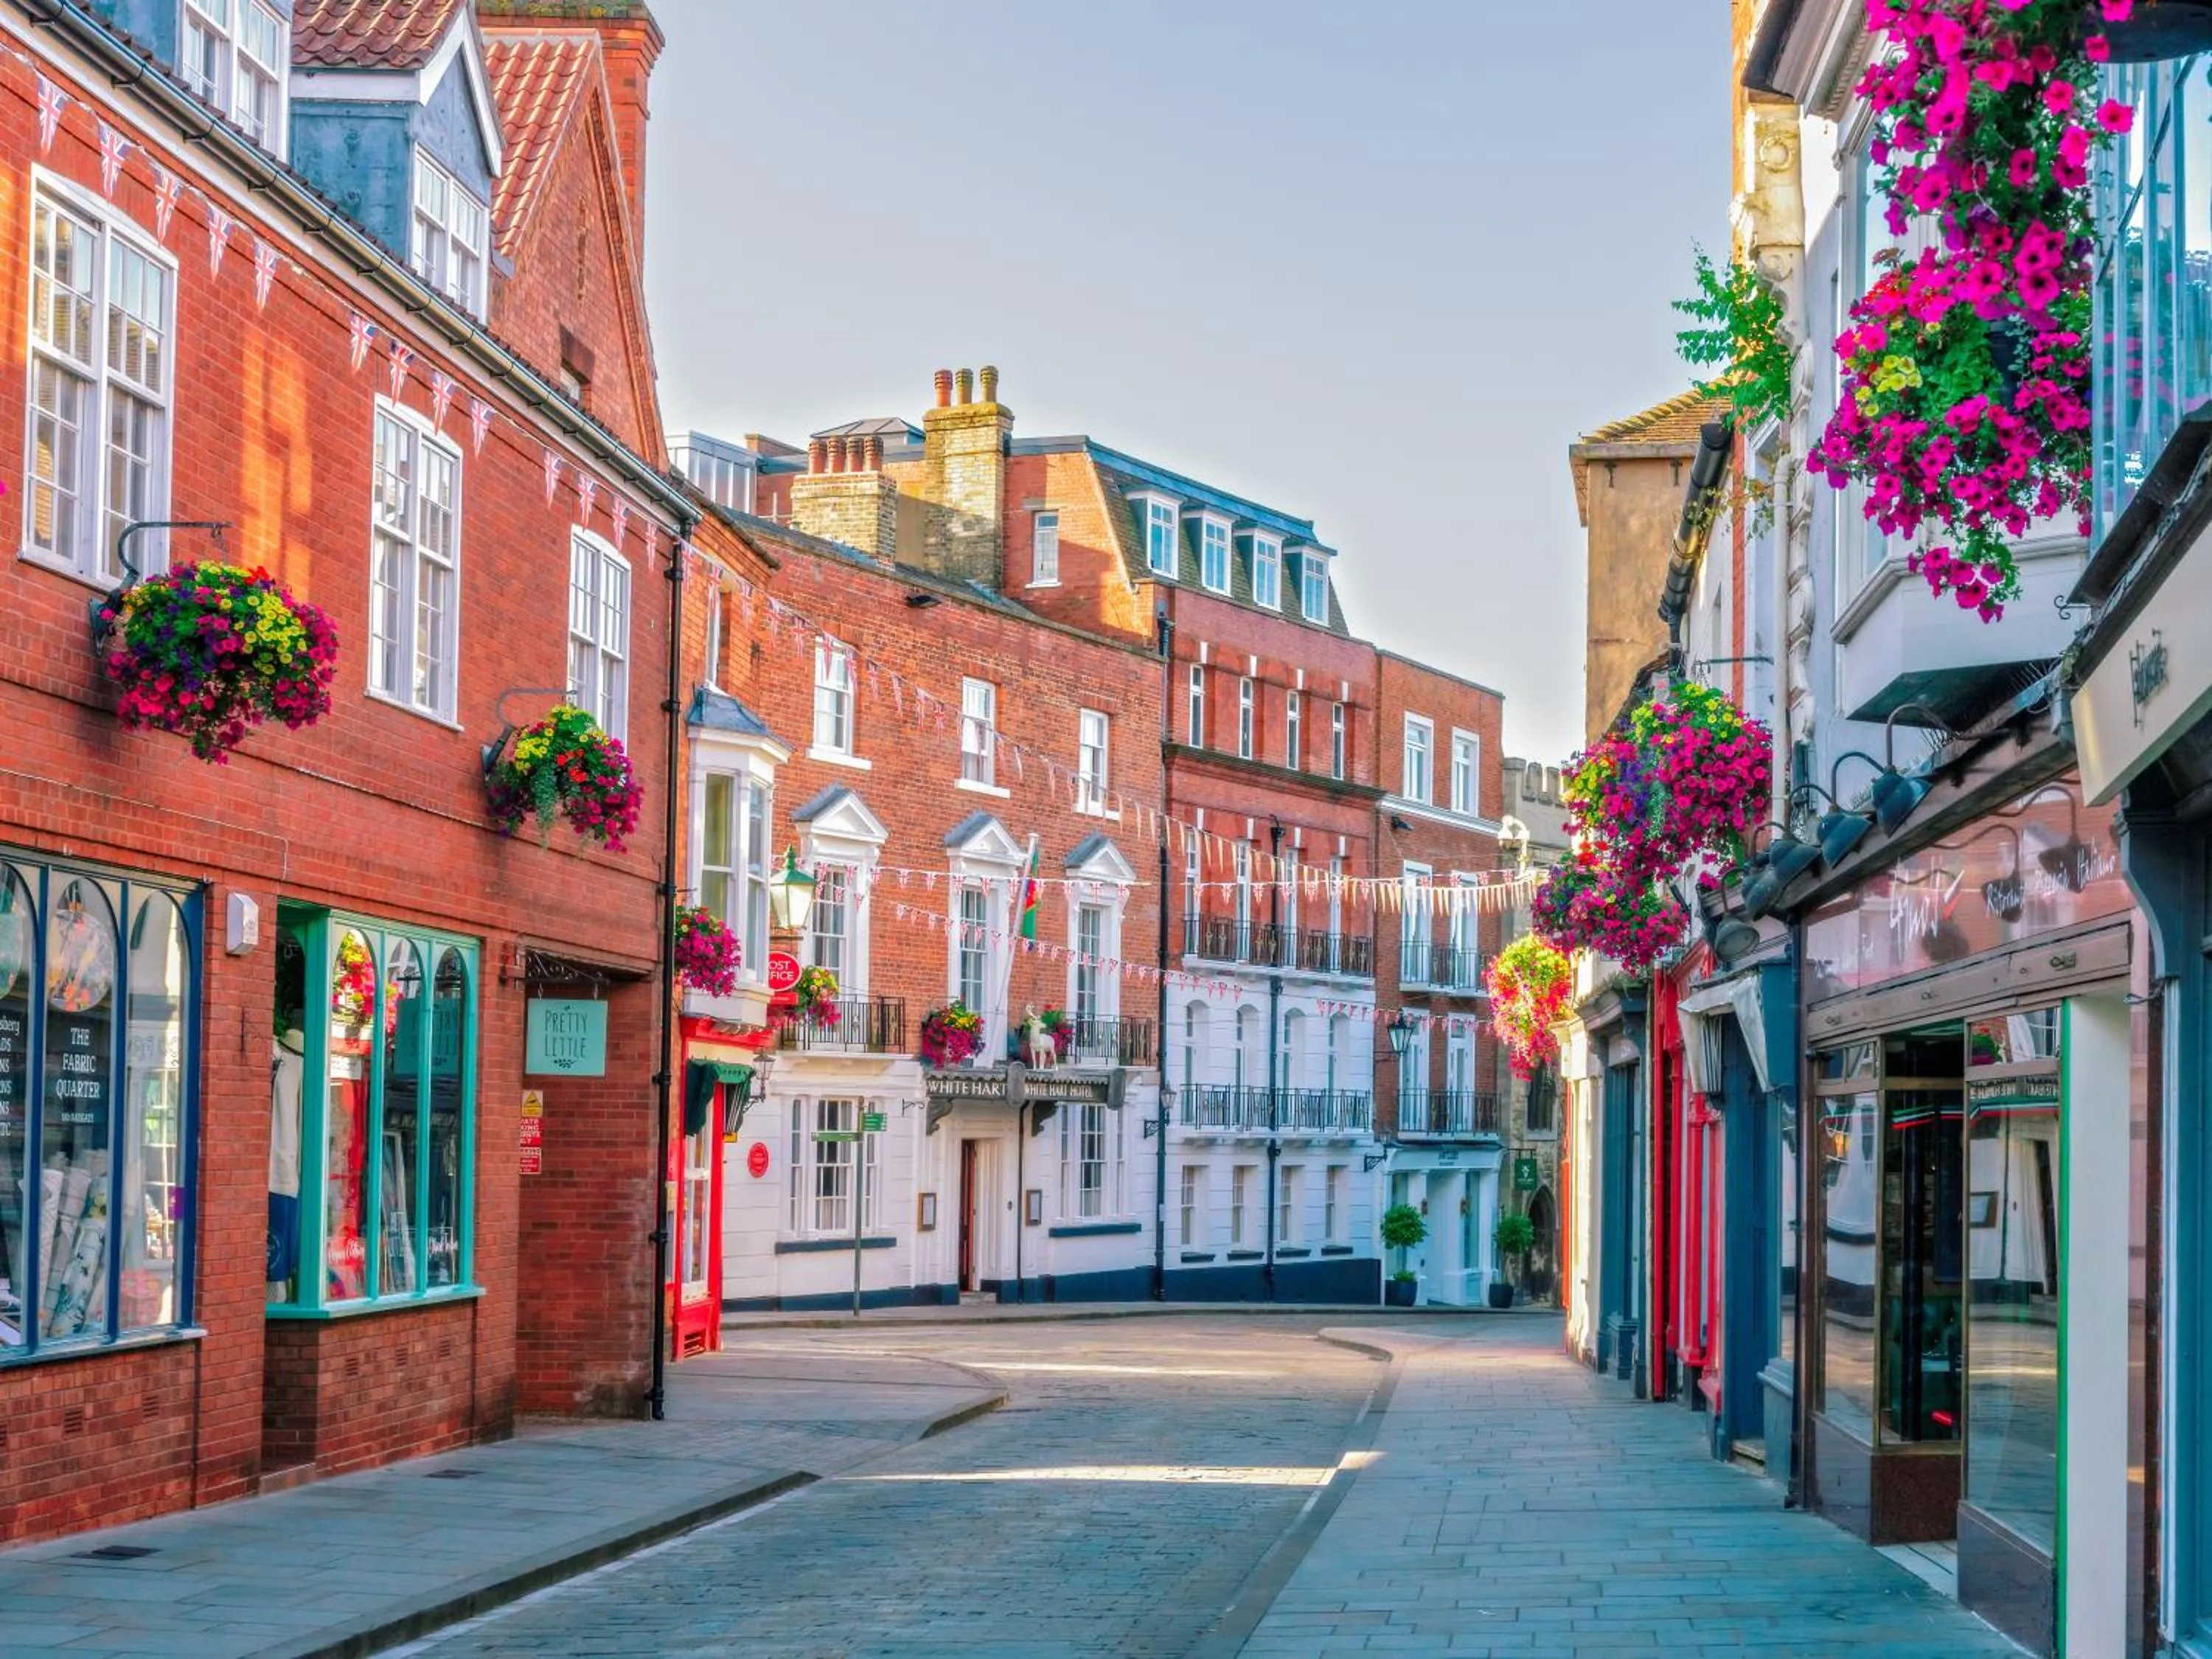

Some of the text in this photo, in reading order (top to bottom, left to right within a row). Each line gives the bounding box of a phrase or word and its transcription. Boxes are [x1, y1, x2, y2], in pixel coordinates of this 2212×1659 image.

[545, 1009, 588, 1033] PRETTY
[71, 1028, 90, 1046] THE
[545, 1034, 587, 1058] LITTLE
[63, 1054, 97, 1072] FABRIC
[56, 1079, 100, 1100] QUARTER
[929, 1080, 1006, 1096] WHITE HART
